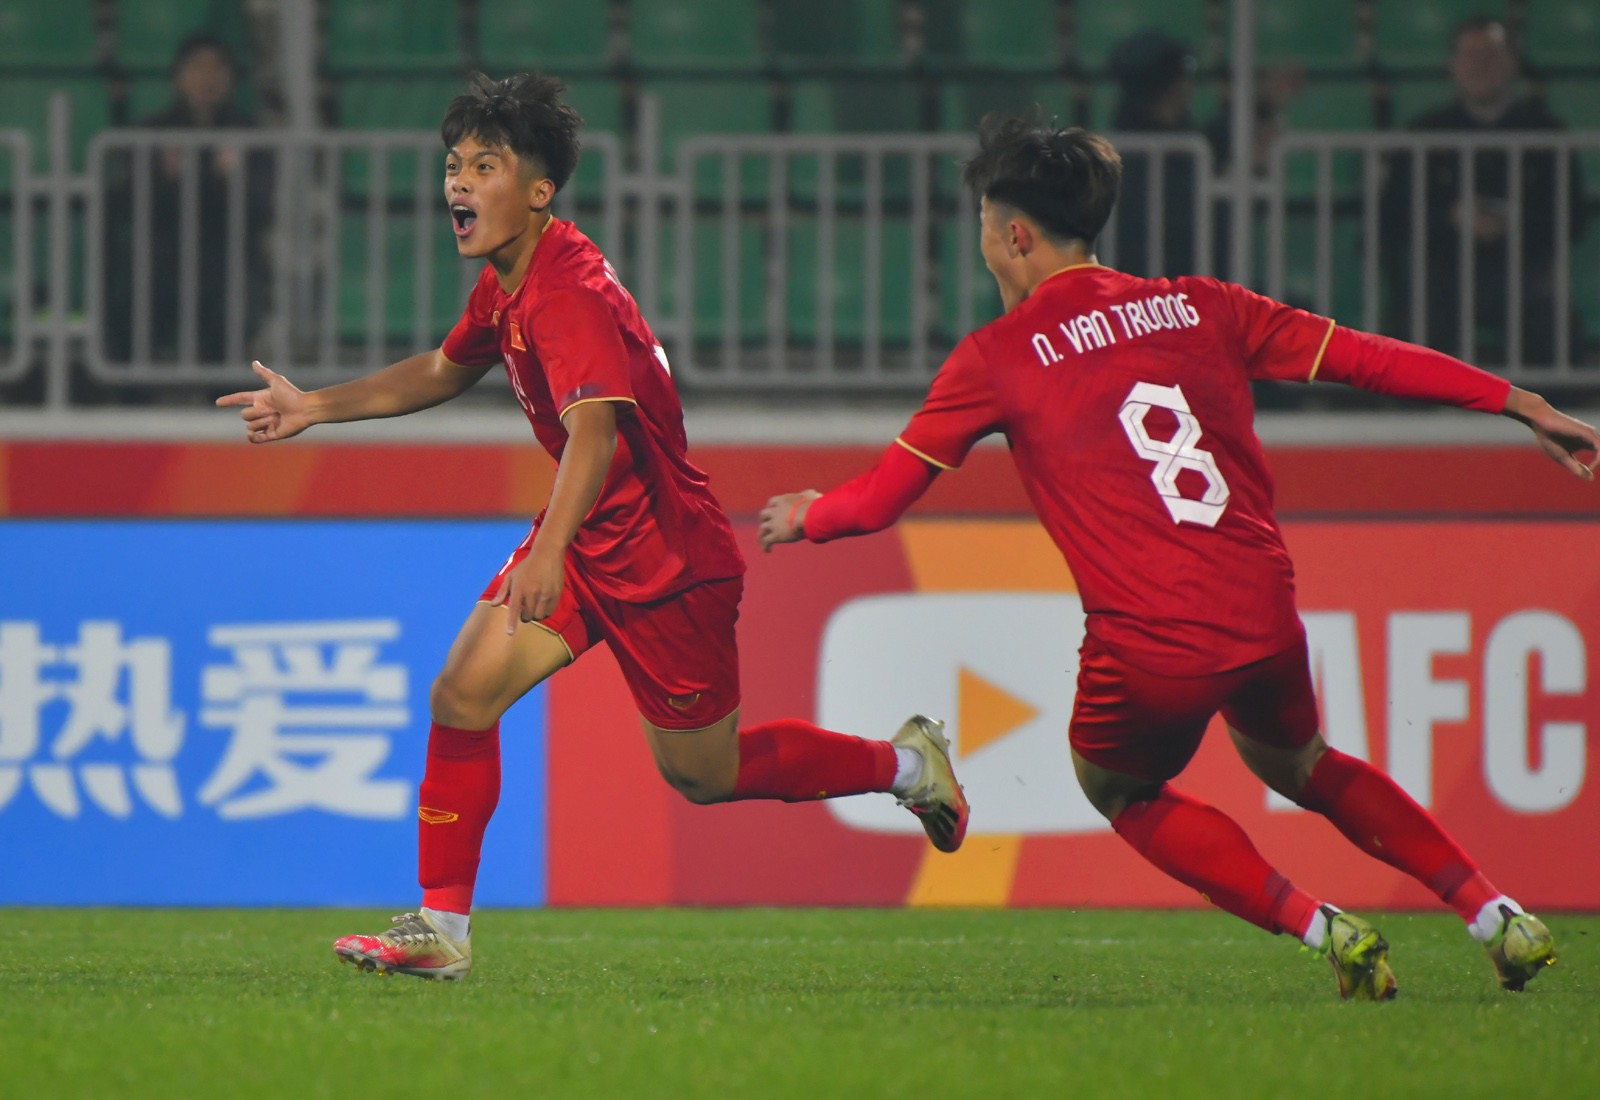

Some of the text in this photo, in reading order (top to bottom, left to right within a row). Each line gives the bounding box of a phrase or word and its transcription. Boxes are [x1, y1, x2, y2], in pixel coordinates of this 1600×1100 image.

[1059, 309, 1117, 354] VAN
[1110, 293, 1201, 340] TRUONG
[1118, 380, 1231, 528] 8
[0, 618, 411, 822] 热爱
